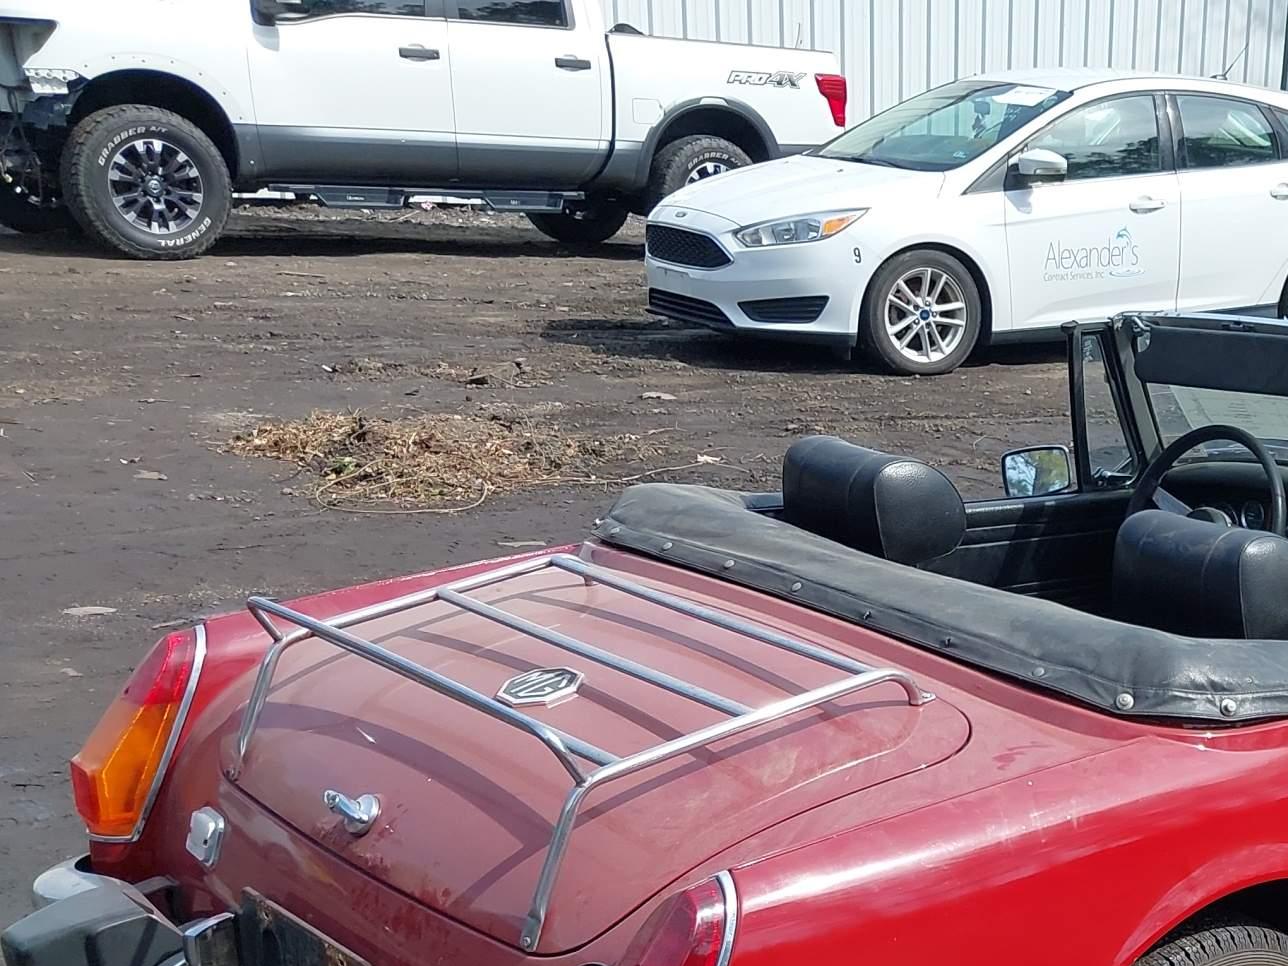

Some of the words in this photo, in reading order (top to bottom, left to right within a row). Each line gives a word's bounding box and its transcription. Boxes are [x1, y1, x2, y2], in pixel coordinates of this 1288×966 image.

[98, 126, 146, 167] GRABBER
[158, 216, 212, 248] GENERAL
[853, 247, 862, 264] 9
[1045, 236, 1139, 270] Alexander's
[510, 671, 573, 697] MG
